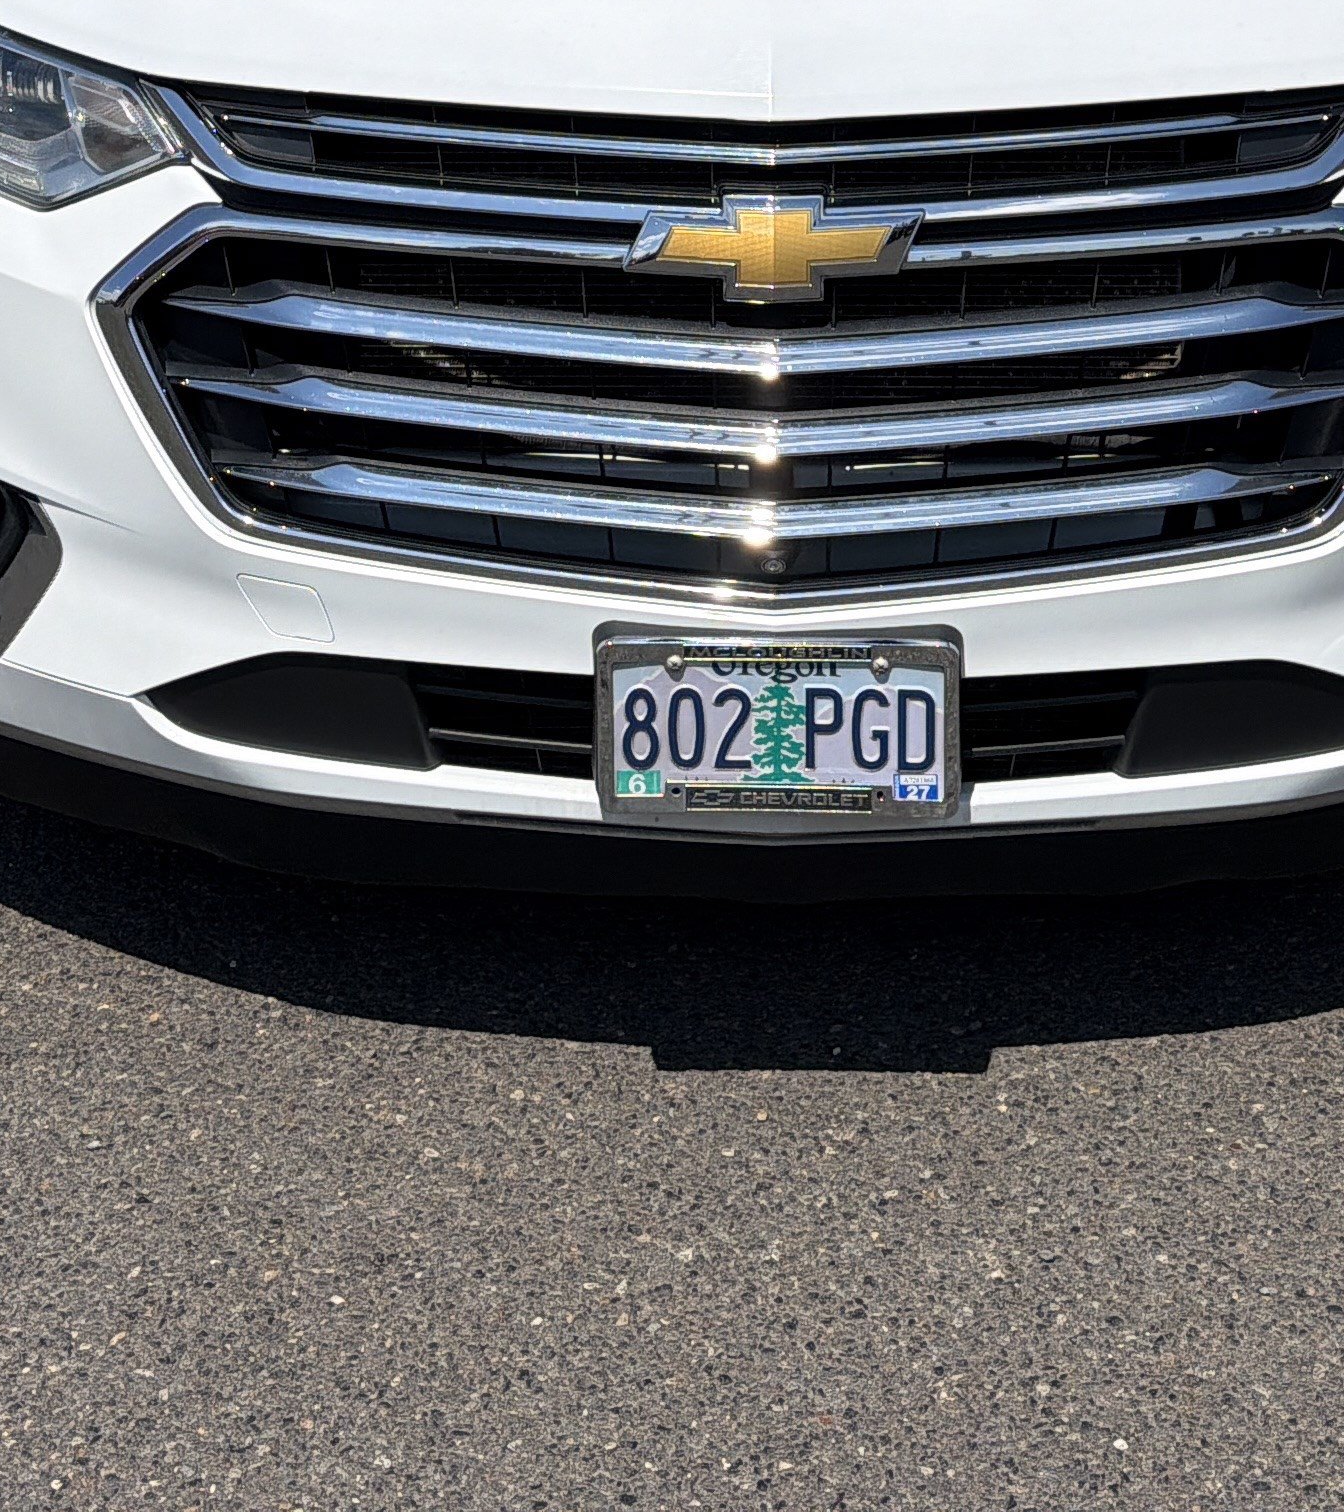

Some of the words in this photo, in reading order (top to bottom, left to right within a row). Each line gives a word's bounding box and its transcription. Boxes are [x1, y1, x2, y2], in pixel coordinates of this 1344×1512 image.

[622, 687, 753, 770] 802
[804, 687, 936, 772] PGD
[628, 773, 646, 795] 6
[906, 785, 931, 801] 27
[739, 791, 869, 807] CHEVROLET
